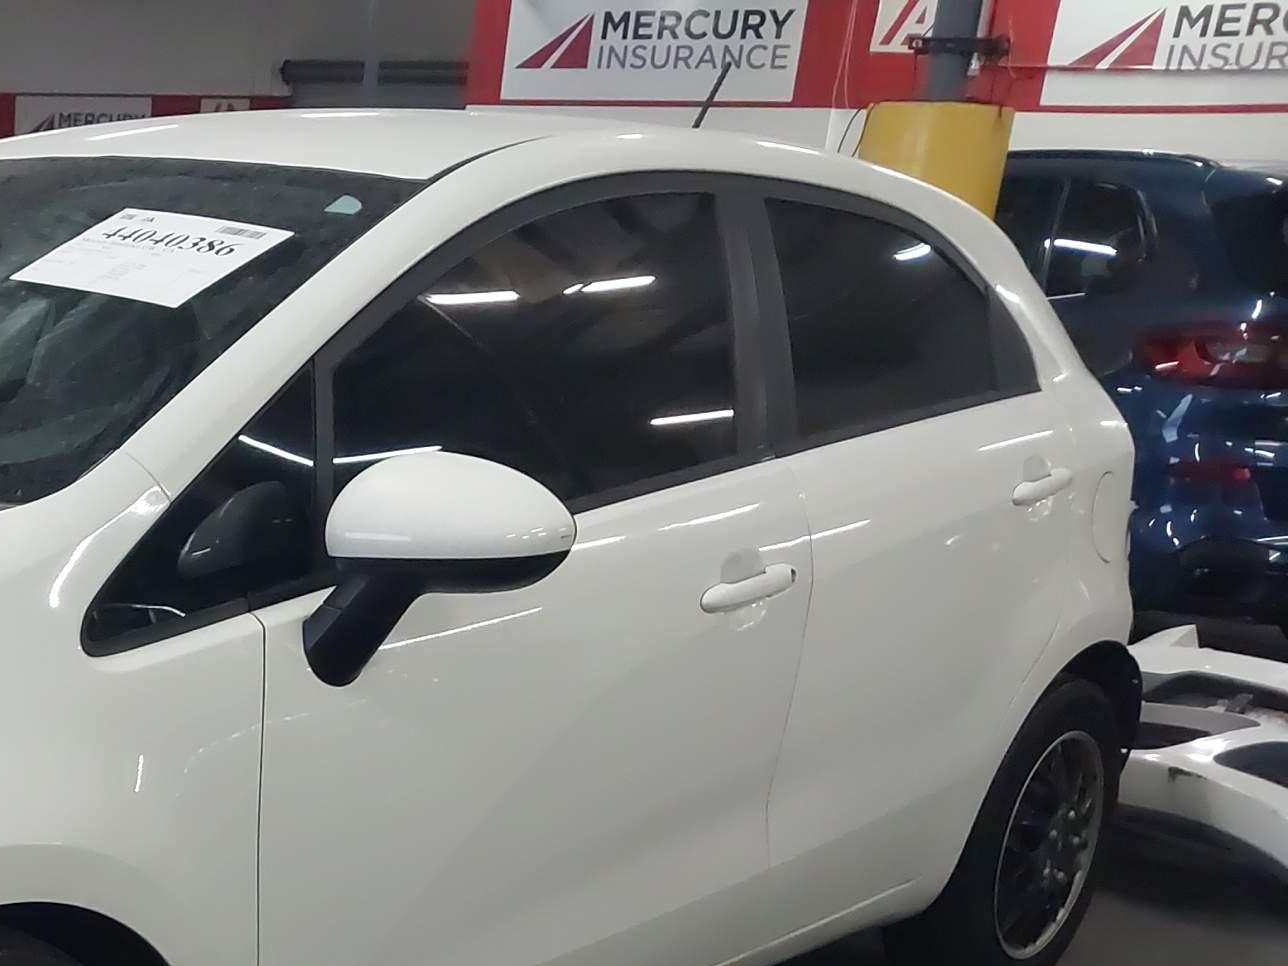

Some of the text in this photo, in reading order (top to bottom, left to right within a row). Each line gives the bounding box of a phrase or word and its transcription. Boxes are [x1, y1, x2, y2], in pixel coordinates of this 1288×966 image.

[600, 9, 795, 40] MERCURY
[1172, 2, 1288, 38] MER
[597, 44, 791, 70] INSURANCE
[101, 226, 244, 257] 44040386
